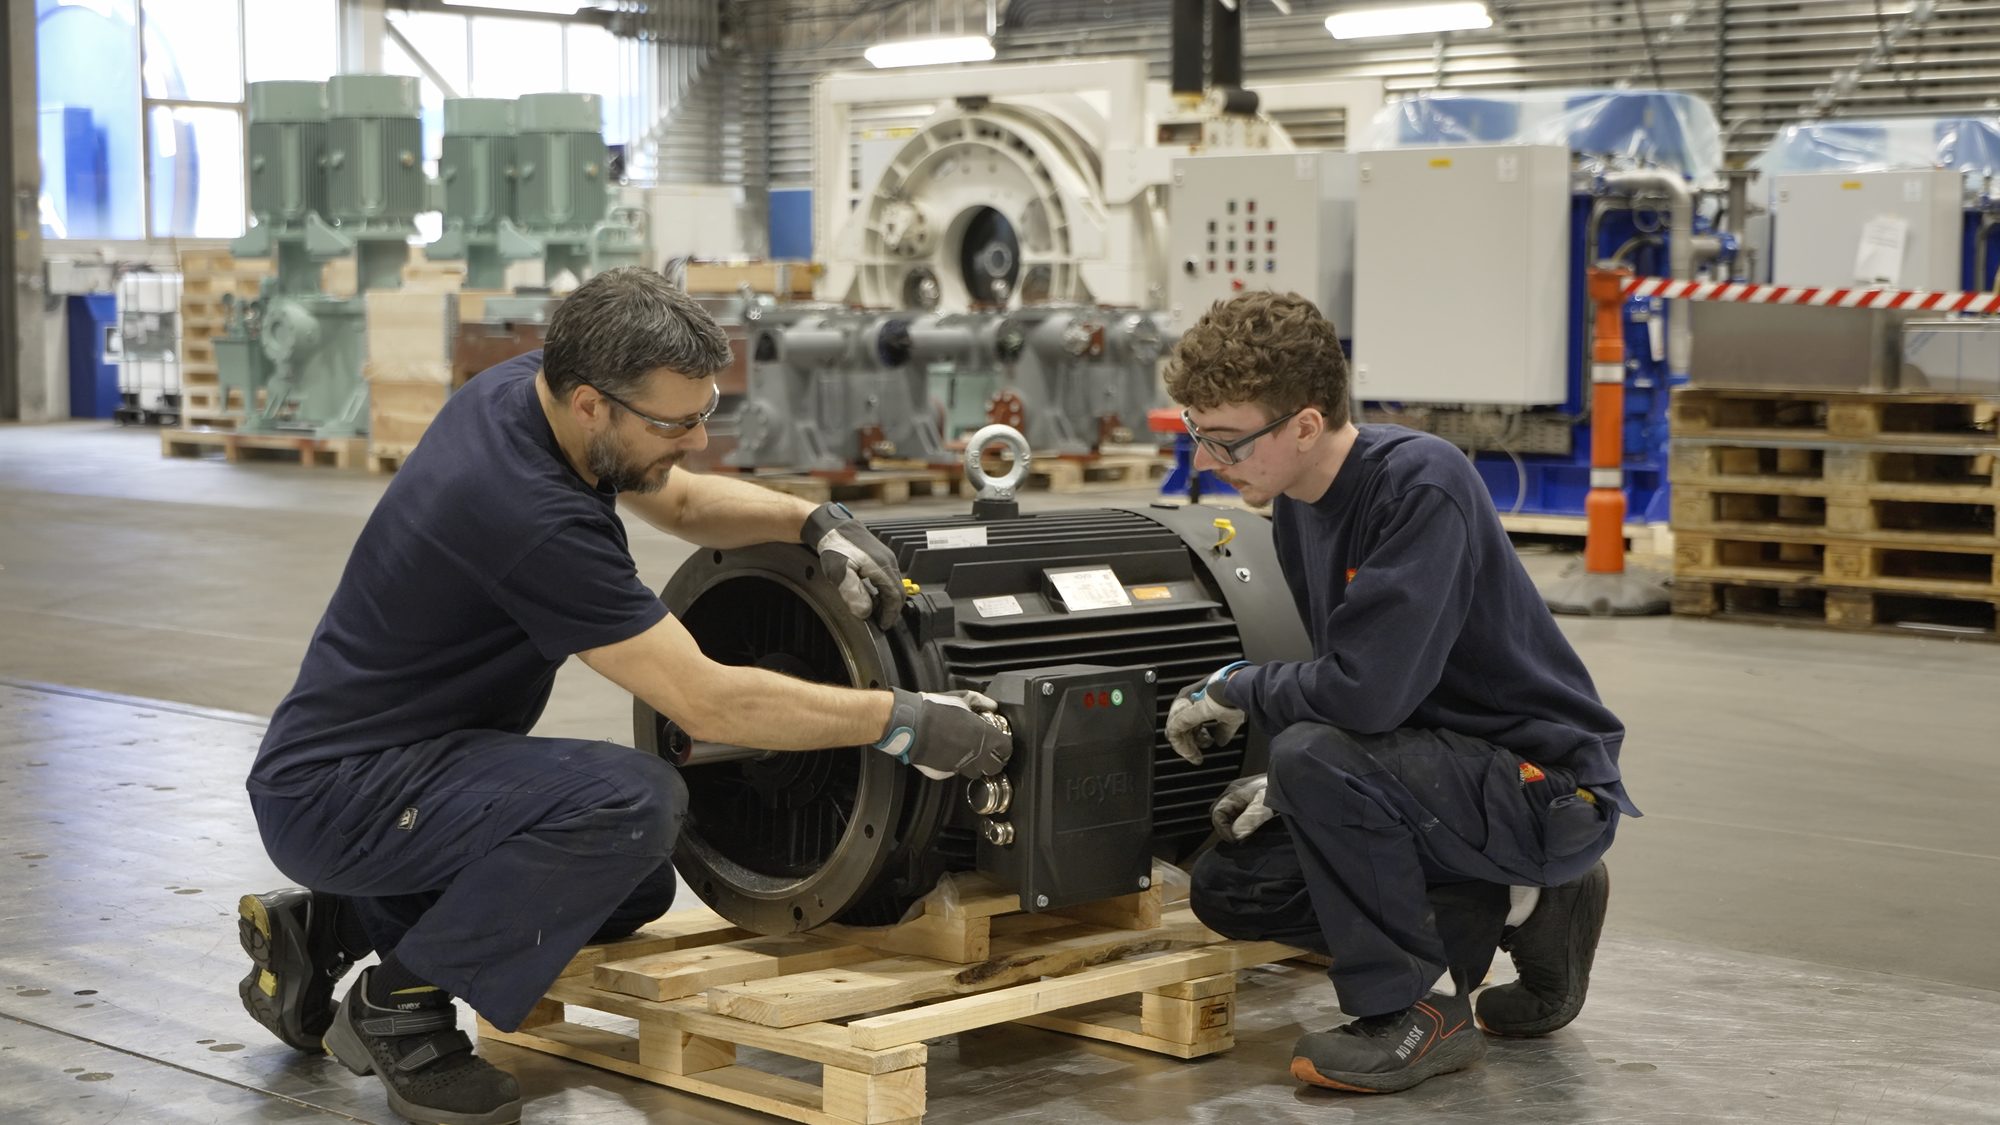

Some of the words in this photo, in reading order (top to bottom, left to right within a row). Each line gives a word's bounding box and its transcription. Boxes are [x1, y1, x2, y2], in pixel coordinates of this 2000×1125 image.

[397, 1002, 420, 1010] uvex
[1395, 1045, 1411, 1060] NO
[1403, 1025, 1424, 1049] RISK
